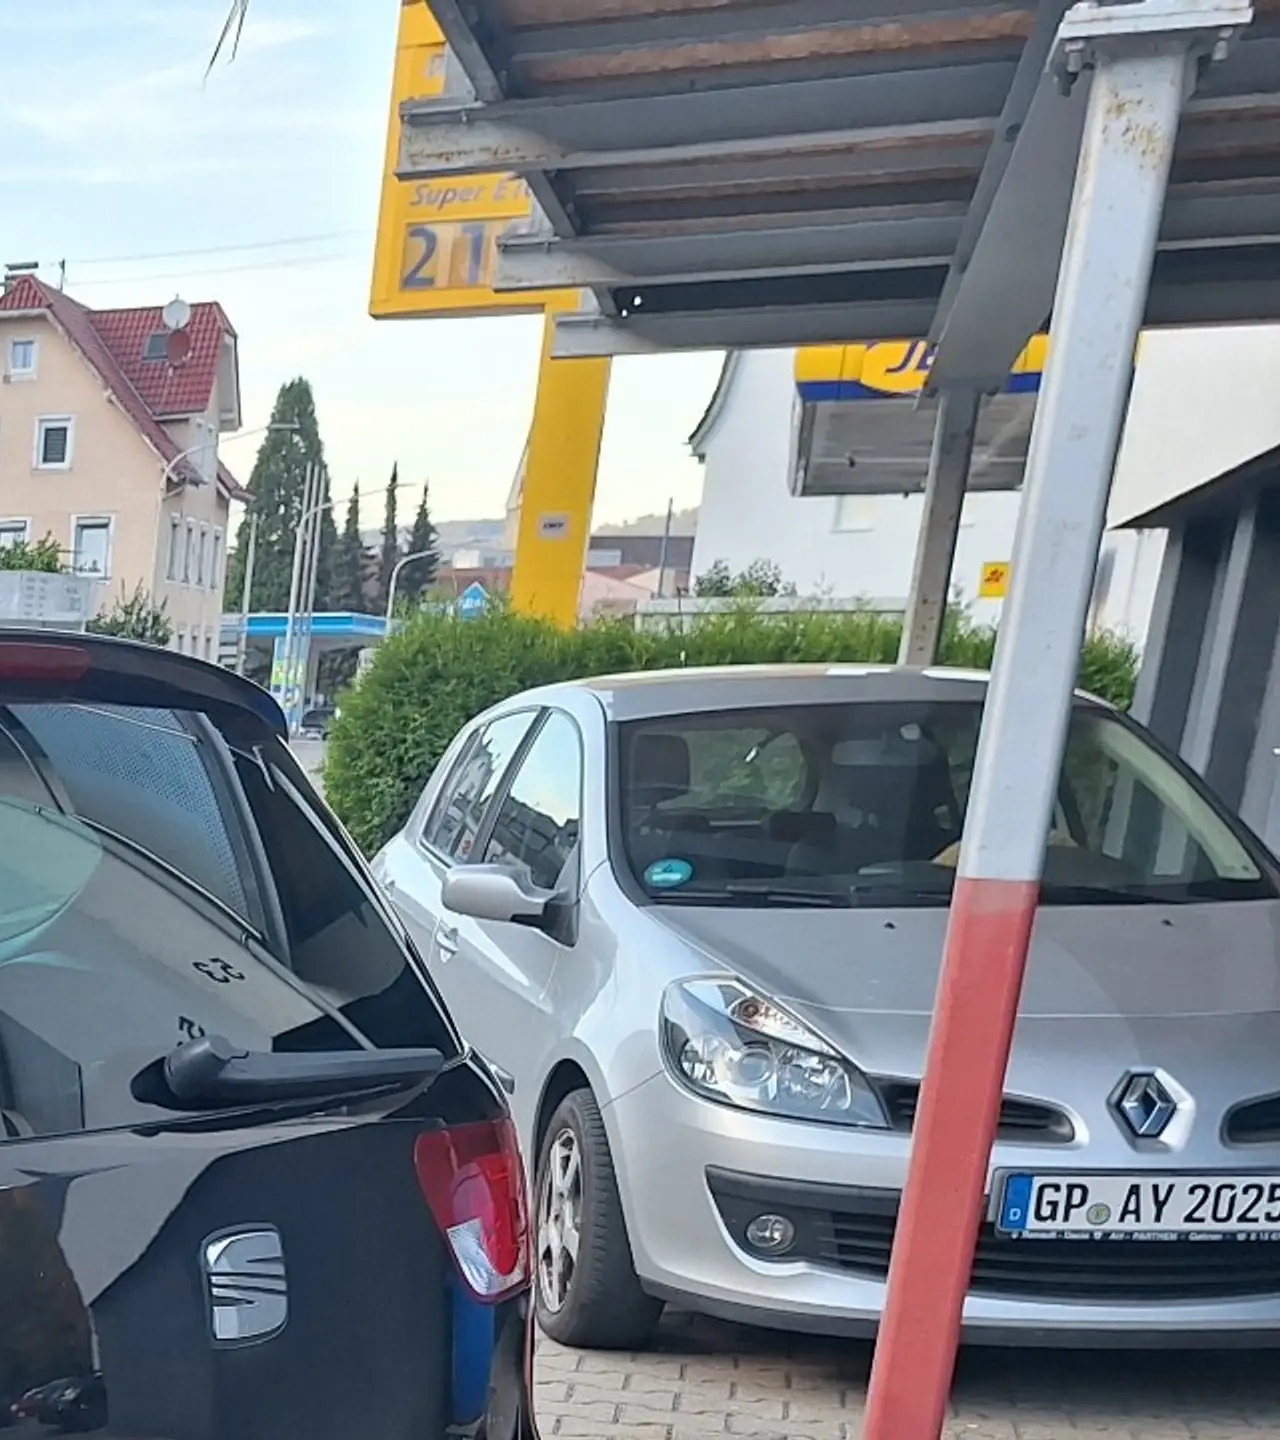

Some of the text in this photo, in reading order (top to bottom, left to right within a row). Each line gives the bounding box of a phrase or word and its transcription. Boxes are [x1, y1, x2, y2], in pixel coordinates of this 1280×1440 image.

[409, 175, 531, 211] Super E1
[402, 223, 485, 288] 21
[1034, 1183, 1089, 1222] GP
[1118, 1183, 1175, 1223] AY
[1183, 1182, 1280, 1223] 2025
